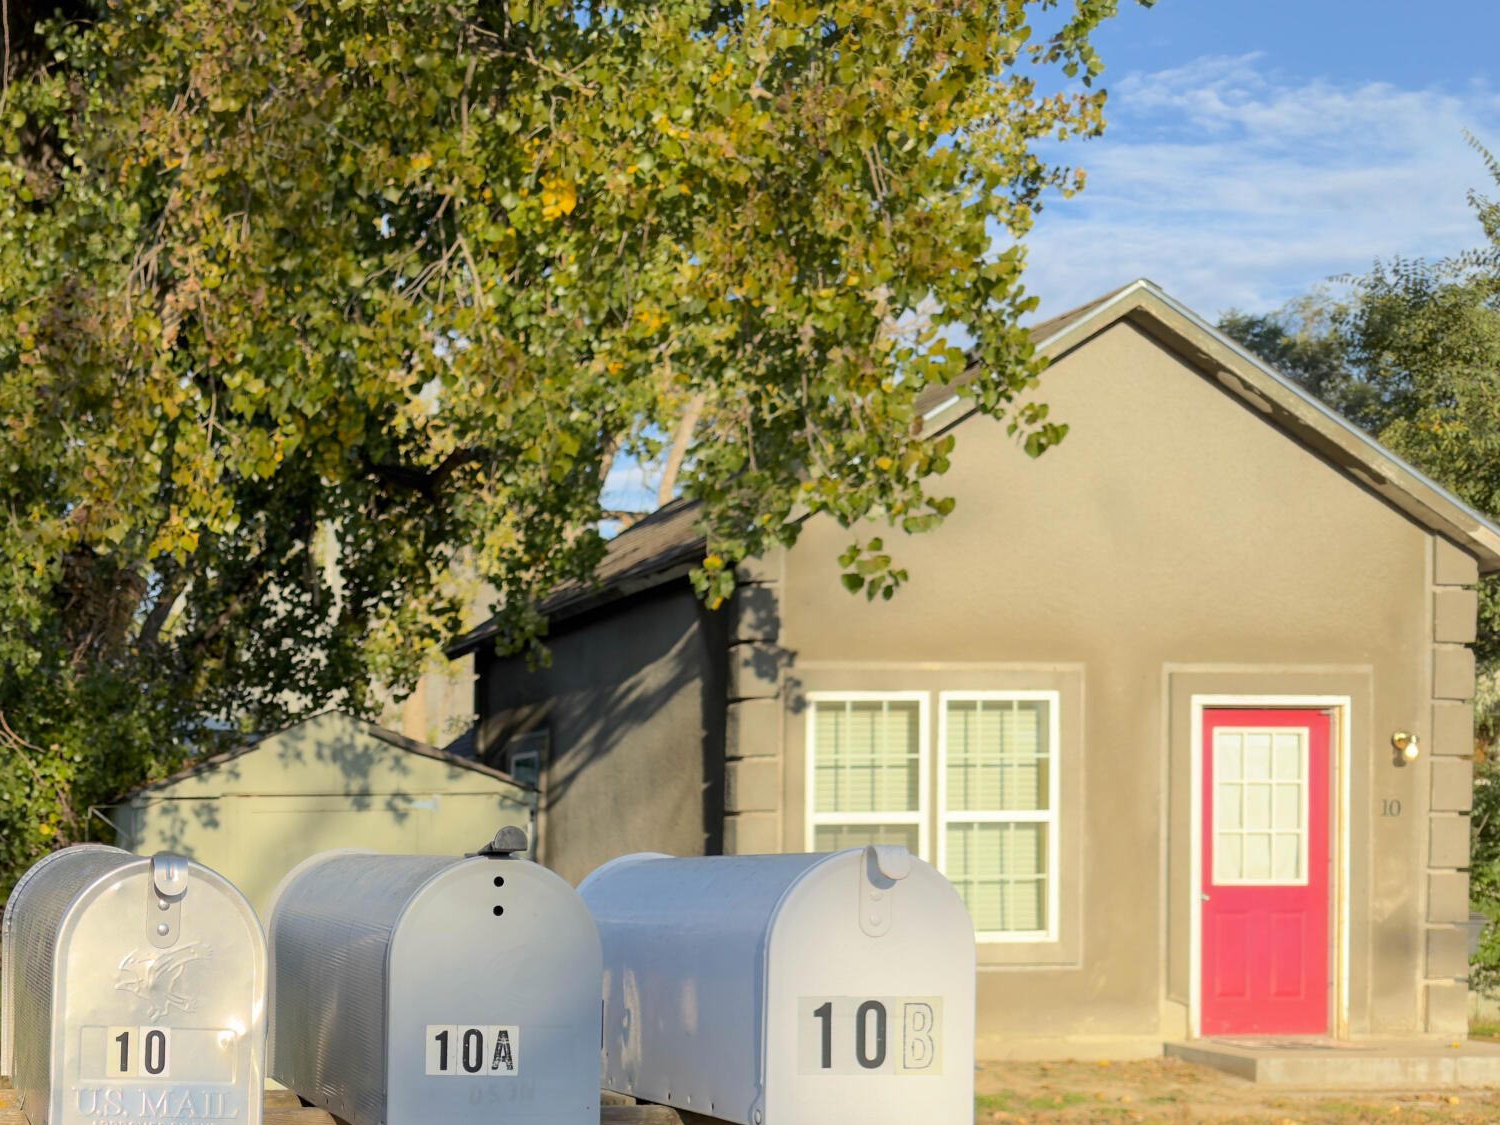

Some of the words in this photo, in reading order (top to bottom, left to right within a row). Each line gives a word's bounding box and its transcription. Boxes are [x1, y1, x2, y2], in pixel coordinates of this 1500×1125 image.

[1380, 798, 1402, 817] 10
[115, 1030, 166, 1074] 10
[435, 1029, 514, 1073] 10A
[813, 1000, 934, 1069] 10B
[71, 1086, 129, 1119] U.S.
[138, 1087, 240, 1120] MAIL
